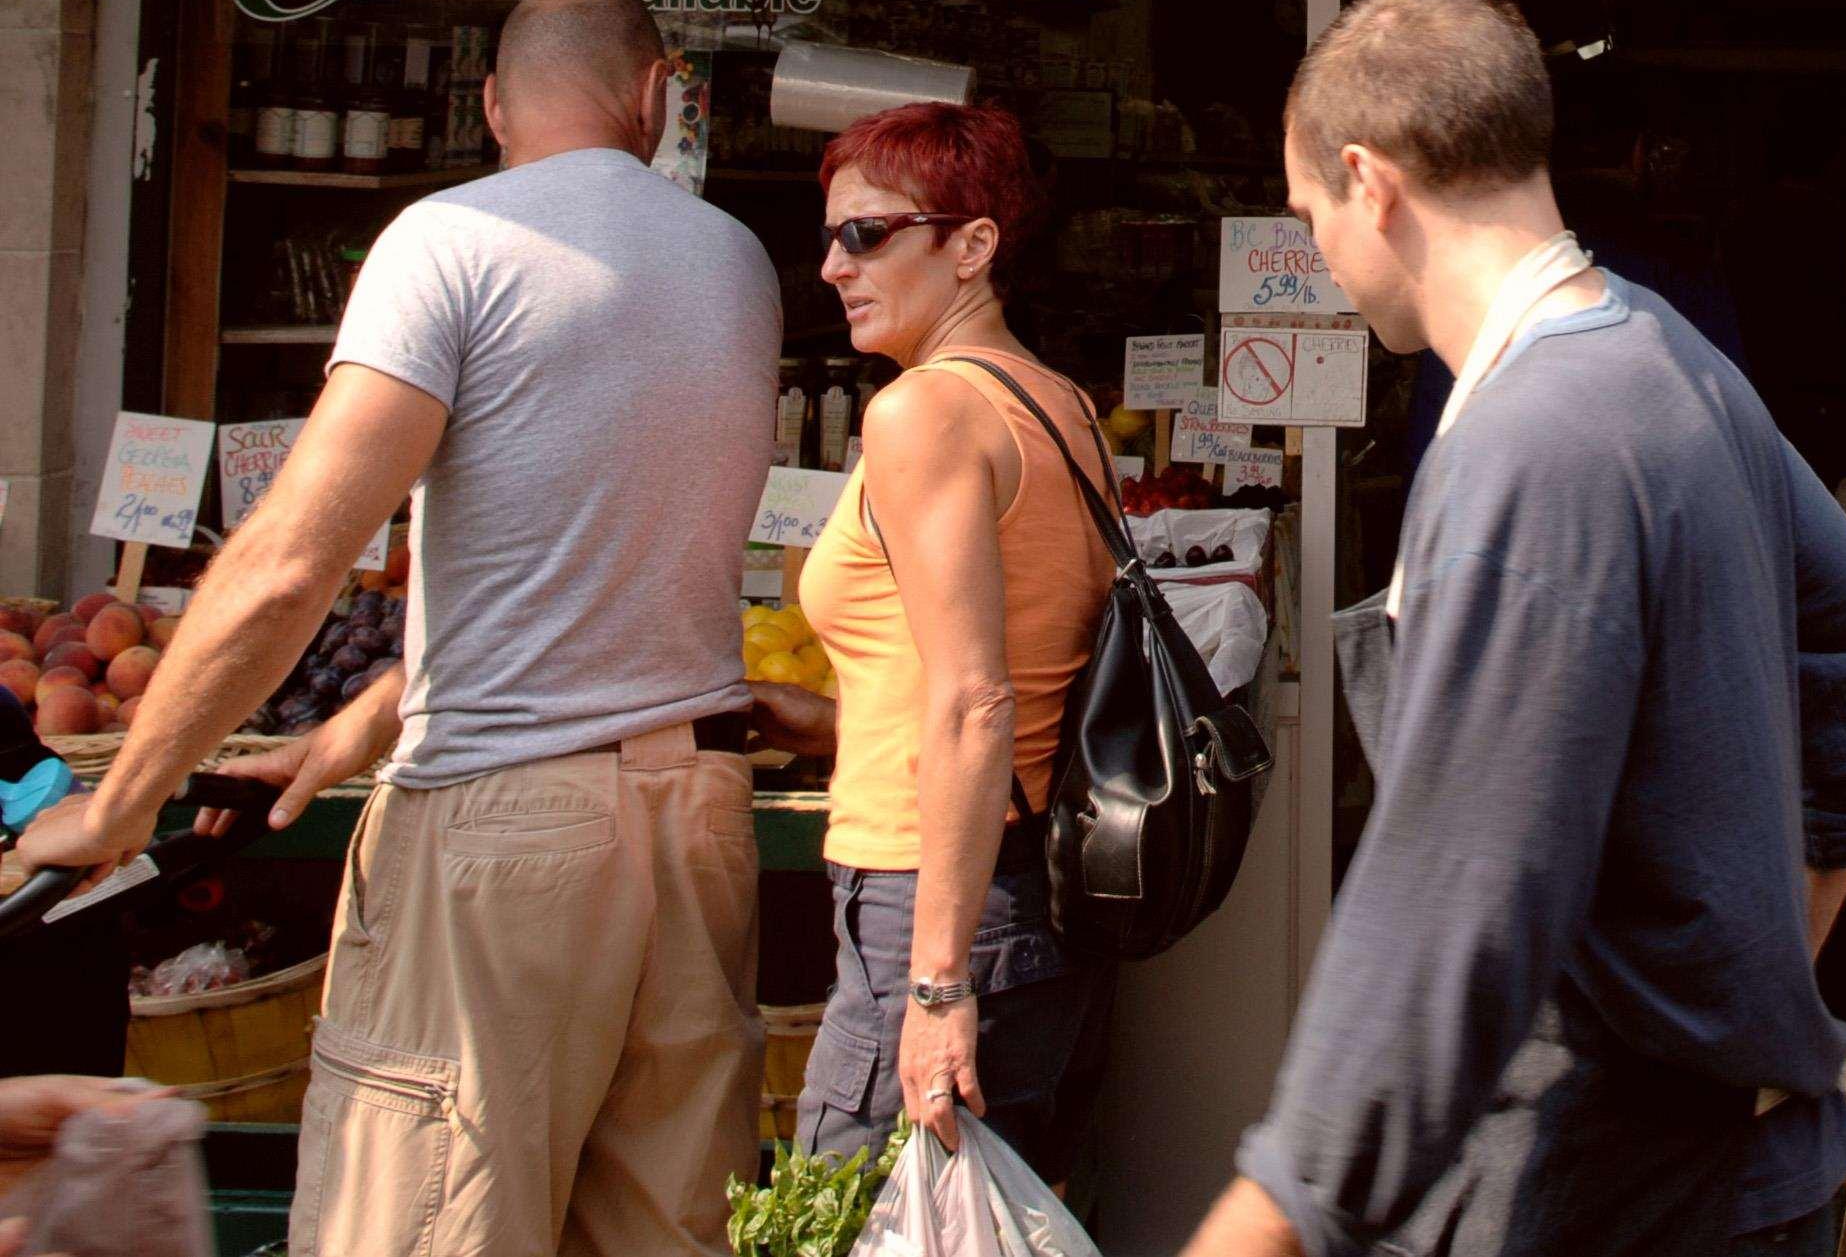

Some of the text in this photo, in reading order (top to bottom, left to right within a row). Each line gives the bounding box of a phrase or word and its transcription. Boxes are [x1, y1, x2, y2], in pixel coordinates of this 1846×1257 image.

[1247, 248, 1331, 275] CHERRIE
[228, 426, 290, 449] SOUR
[225, 448, 291, 478] CHERRIE
